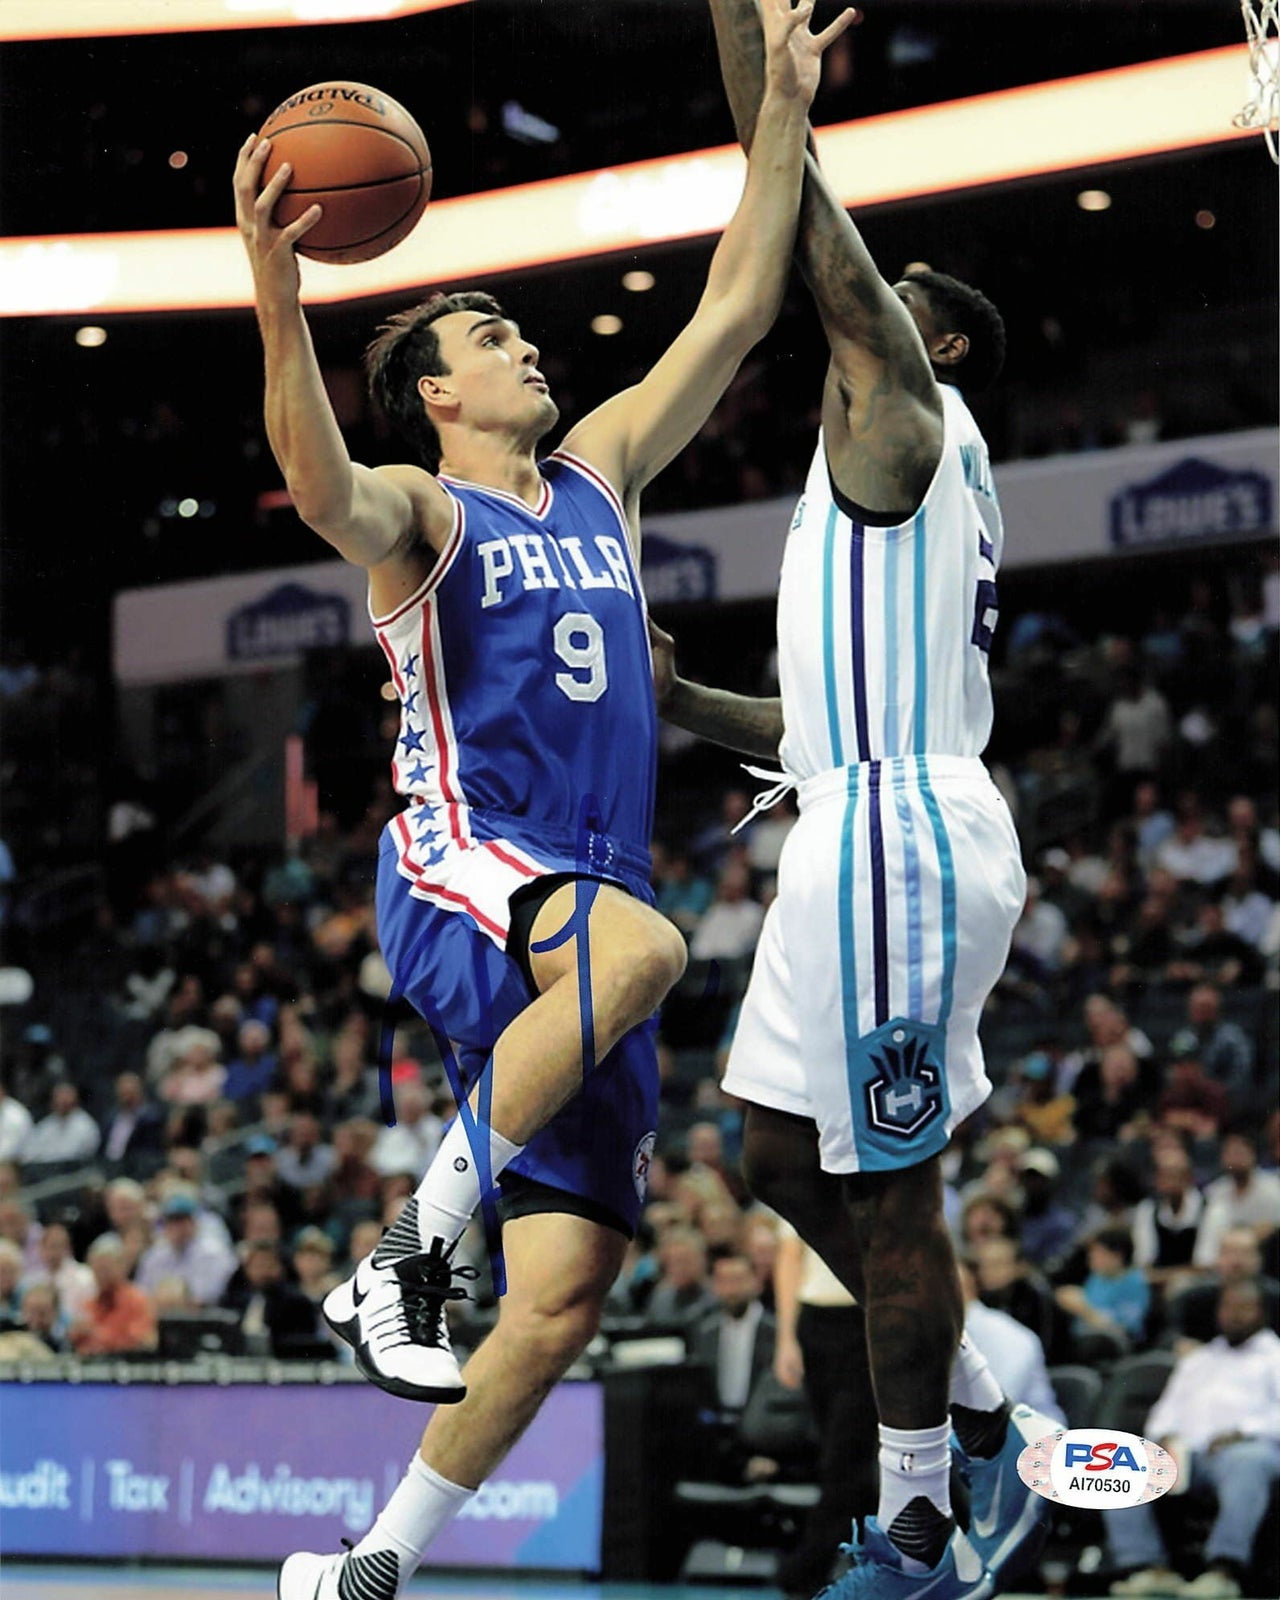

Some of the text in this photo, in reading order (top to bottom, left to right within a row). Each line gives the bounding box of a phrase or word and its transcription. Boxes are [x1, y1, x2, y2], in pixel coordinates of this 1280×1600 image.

[553, 611, 609, 703] 9
[0, 1458, 71, 1509] udit
[104, 1458, 169, 1511] Tax
[202, 1461, 375, 1532] Advisory
